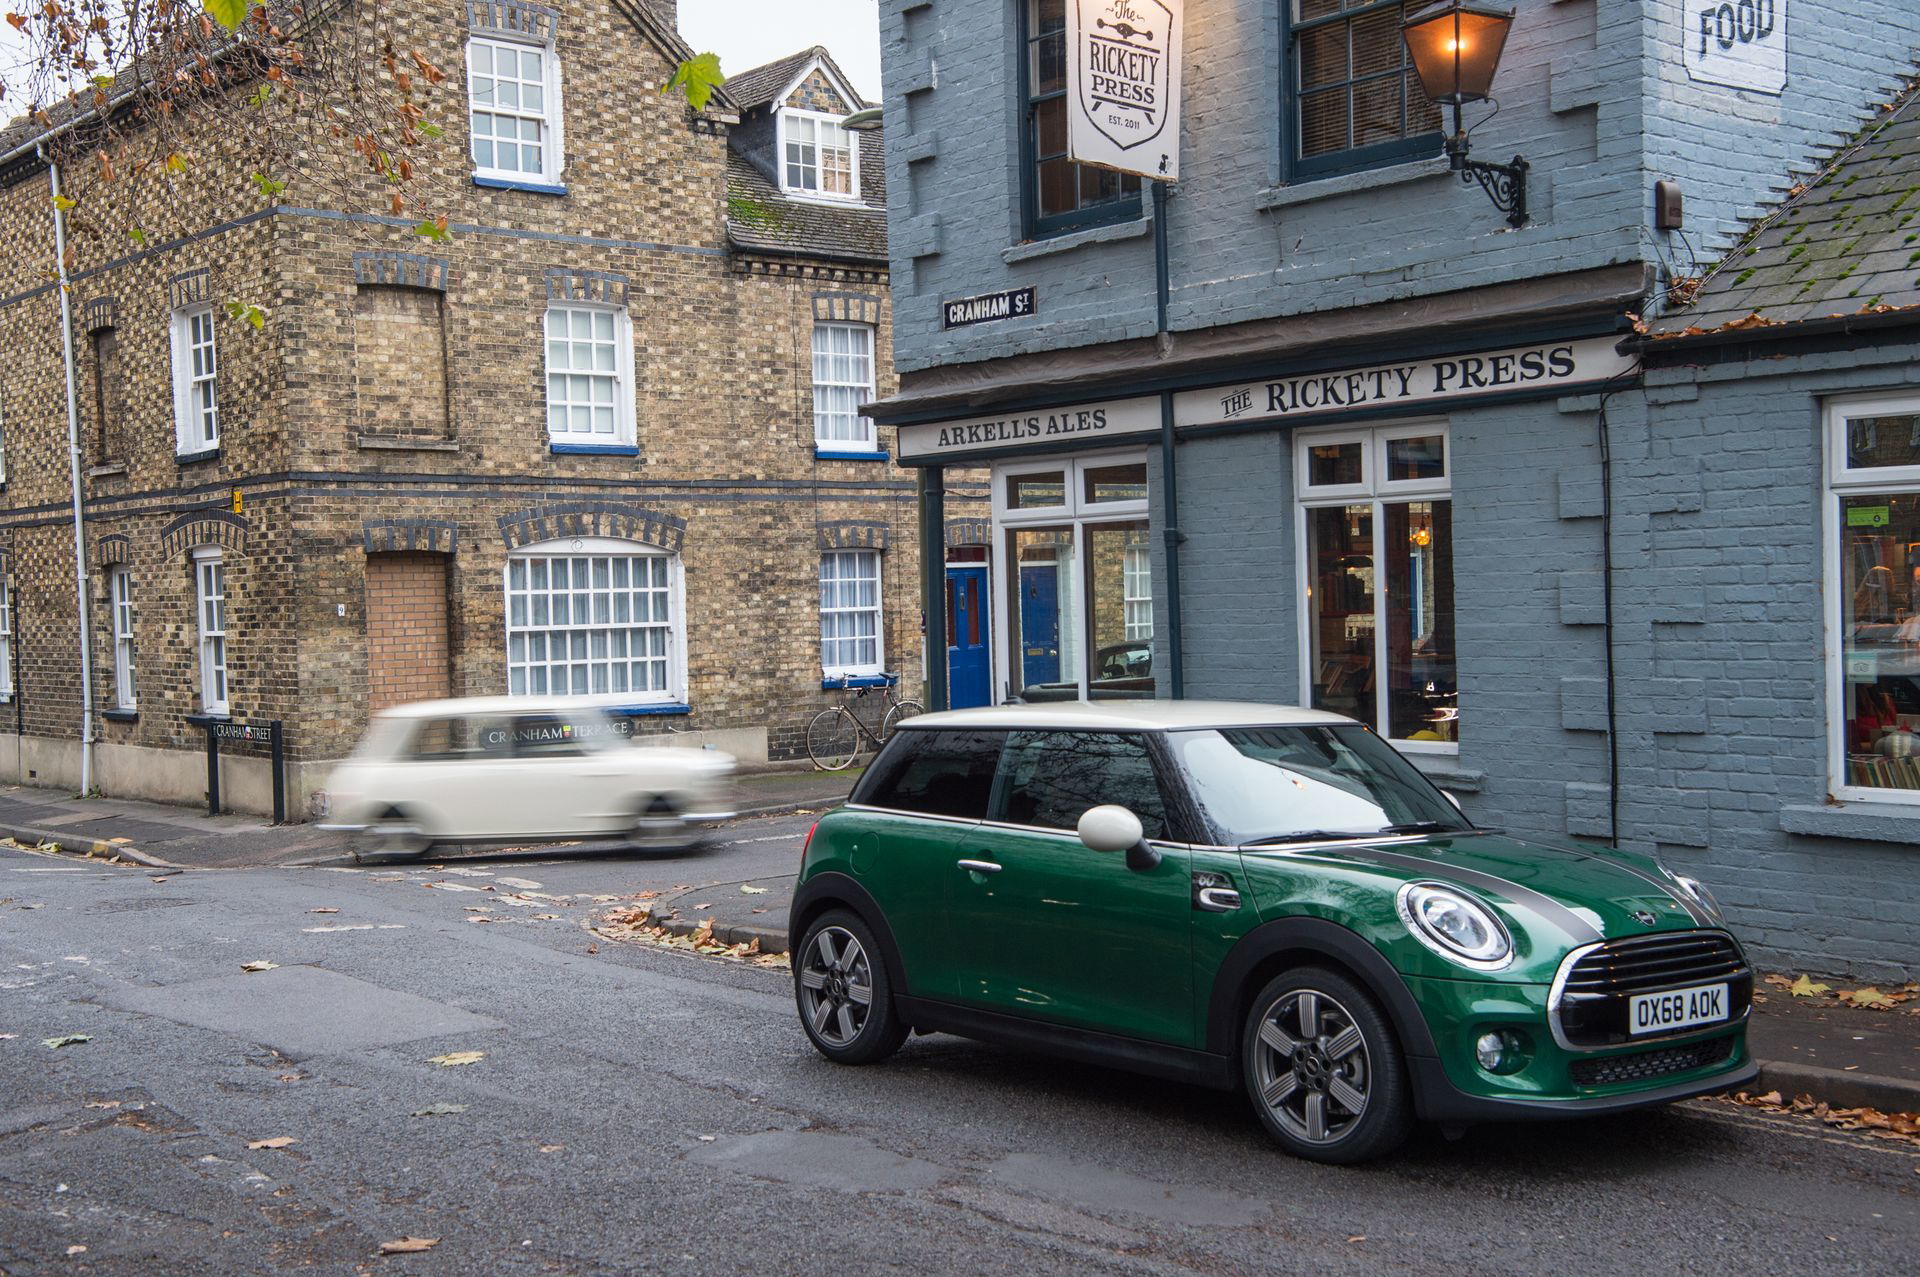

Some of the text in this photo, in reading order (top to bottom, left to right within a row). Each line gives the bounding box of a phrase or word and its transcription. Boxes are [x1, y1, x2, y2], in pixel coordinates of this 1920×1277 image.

[1114, 0, 1136, 22] The
[1699, 0, 1775, 57] FOOD
[1089, 40, 1160, 86] RICKETY
[1091, 74, 1155, 105] PRESS
[1108, 114, 1141, 130] EST. 2011
[949, 296, 1010, 323] CRANHAM
[1221, 346, 1575, 415] THE RICKETY PRESS
[937, 409, 1107, 447] ARKELL'S ALES
[216, 724, 247, 738] CRANHAM
[250, 727, 271, 740] STREET
[488, 722, 628, 744] CRANHAM TERRACE
[1638, 989, 1721, 1027] OX68 AOK
